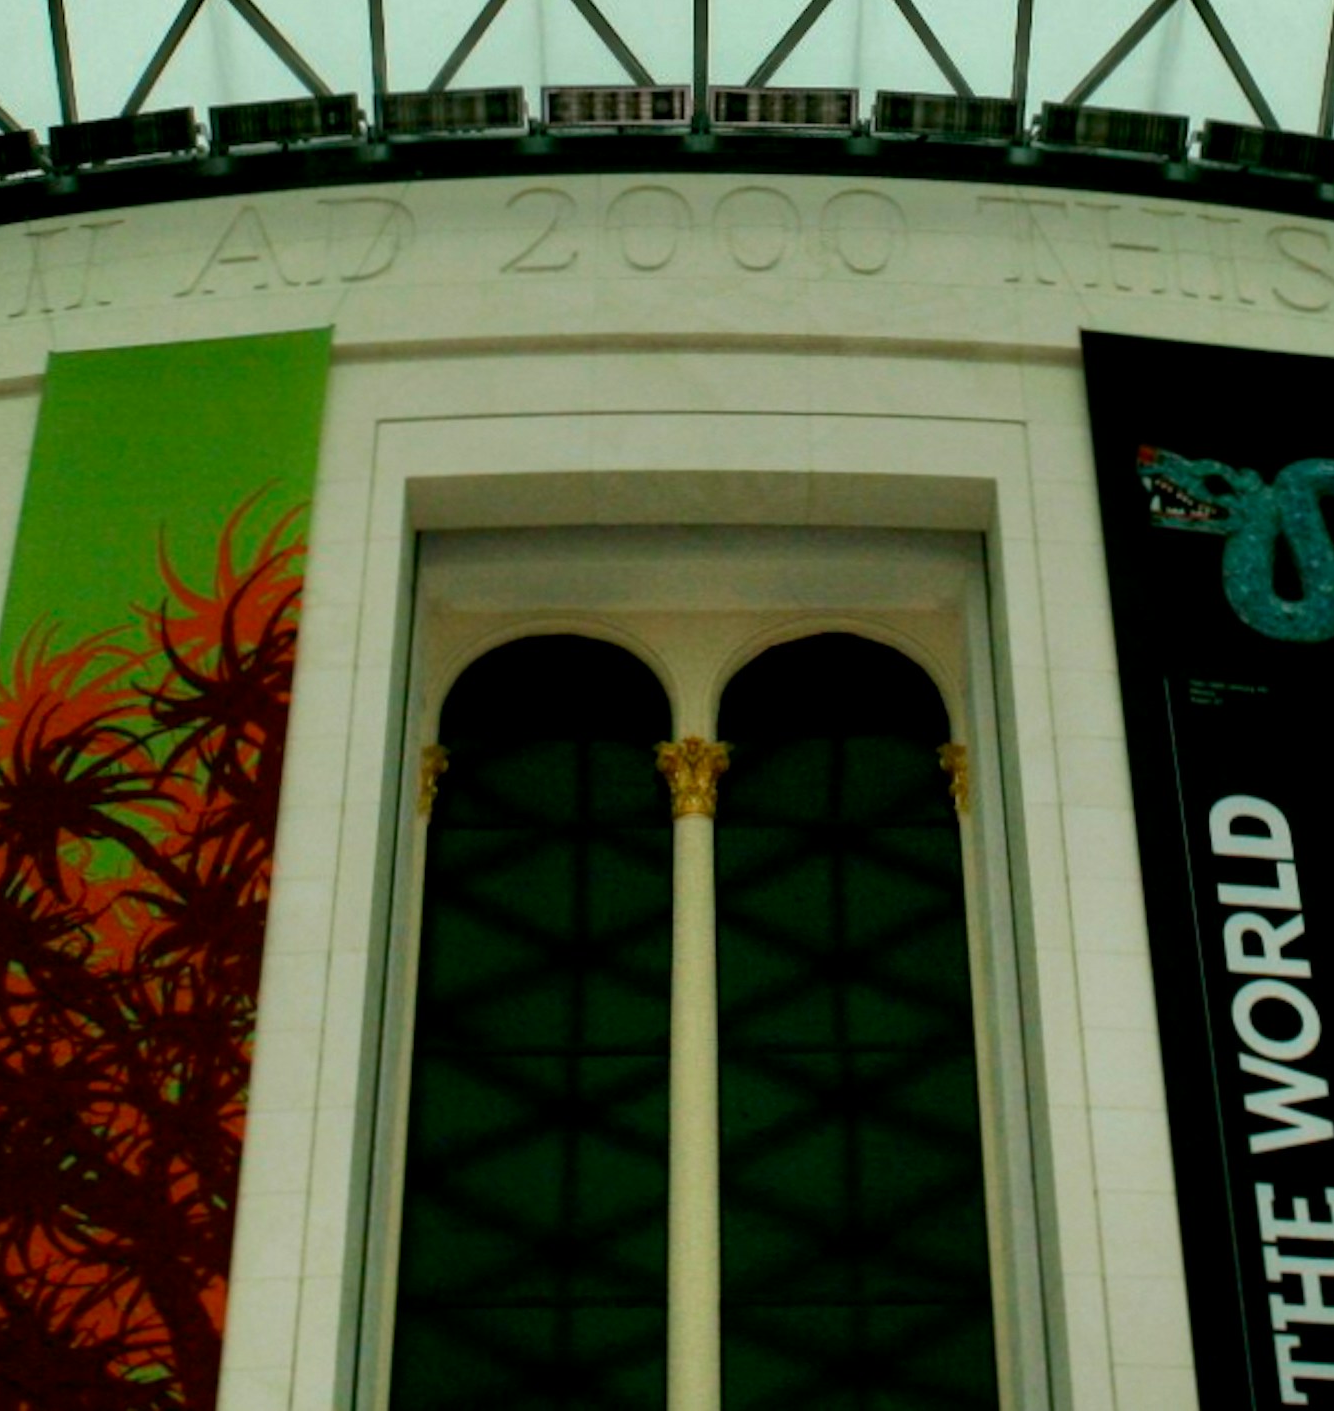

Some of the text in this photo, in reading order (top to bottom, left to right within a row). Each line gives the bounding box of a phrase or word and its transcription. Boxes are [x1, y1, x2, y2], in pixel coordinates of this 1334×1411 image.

[7, 218, 126, 320] II
[172, 195, 418, 299] AD
[498, 183, 909, 277] 2000
